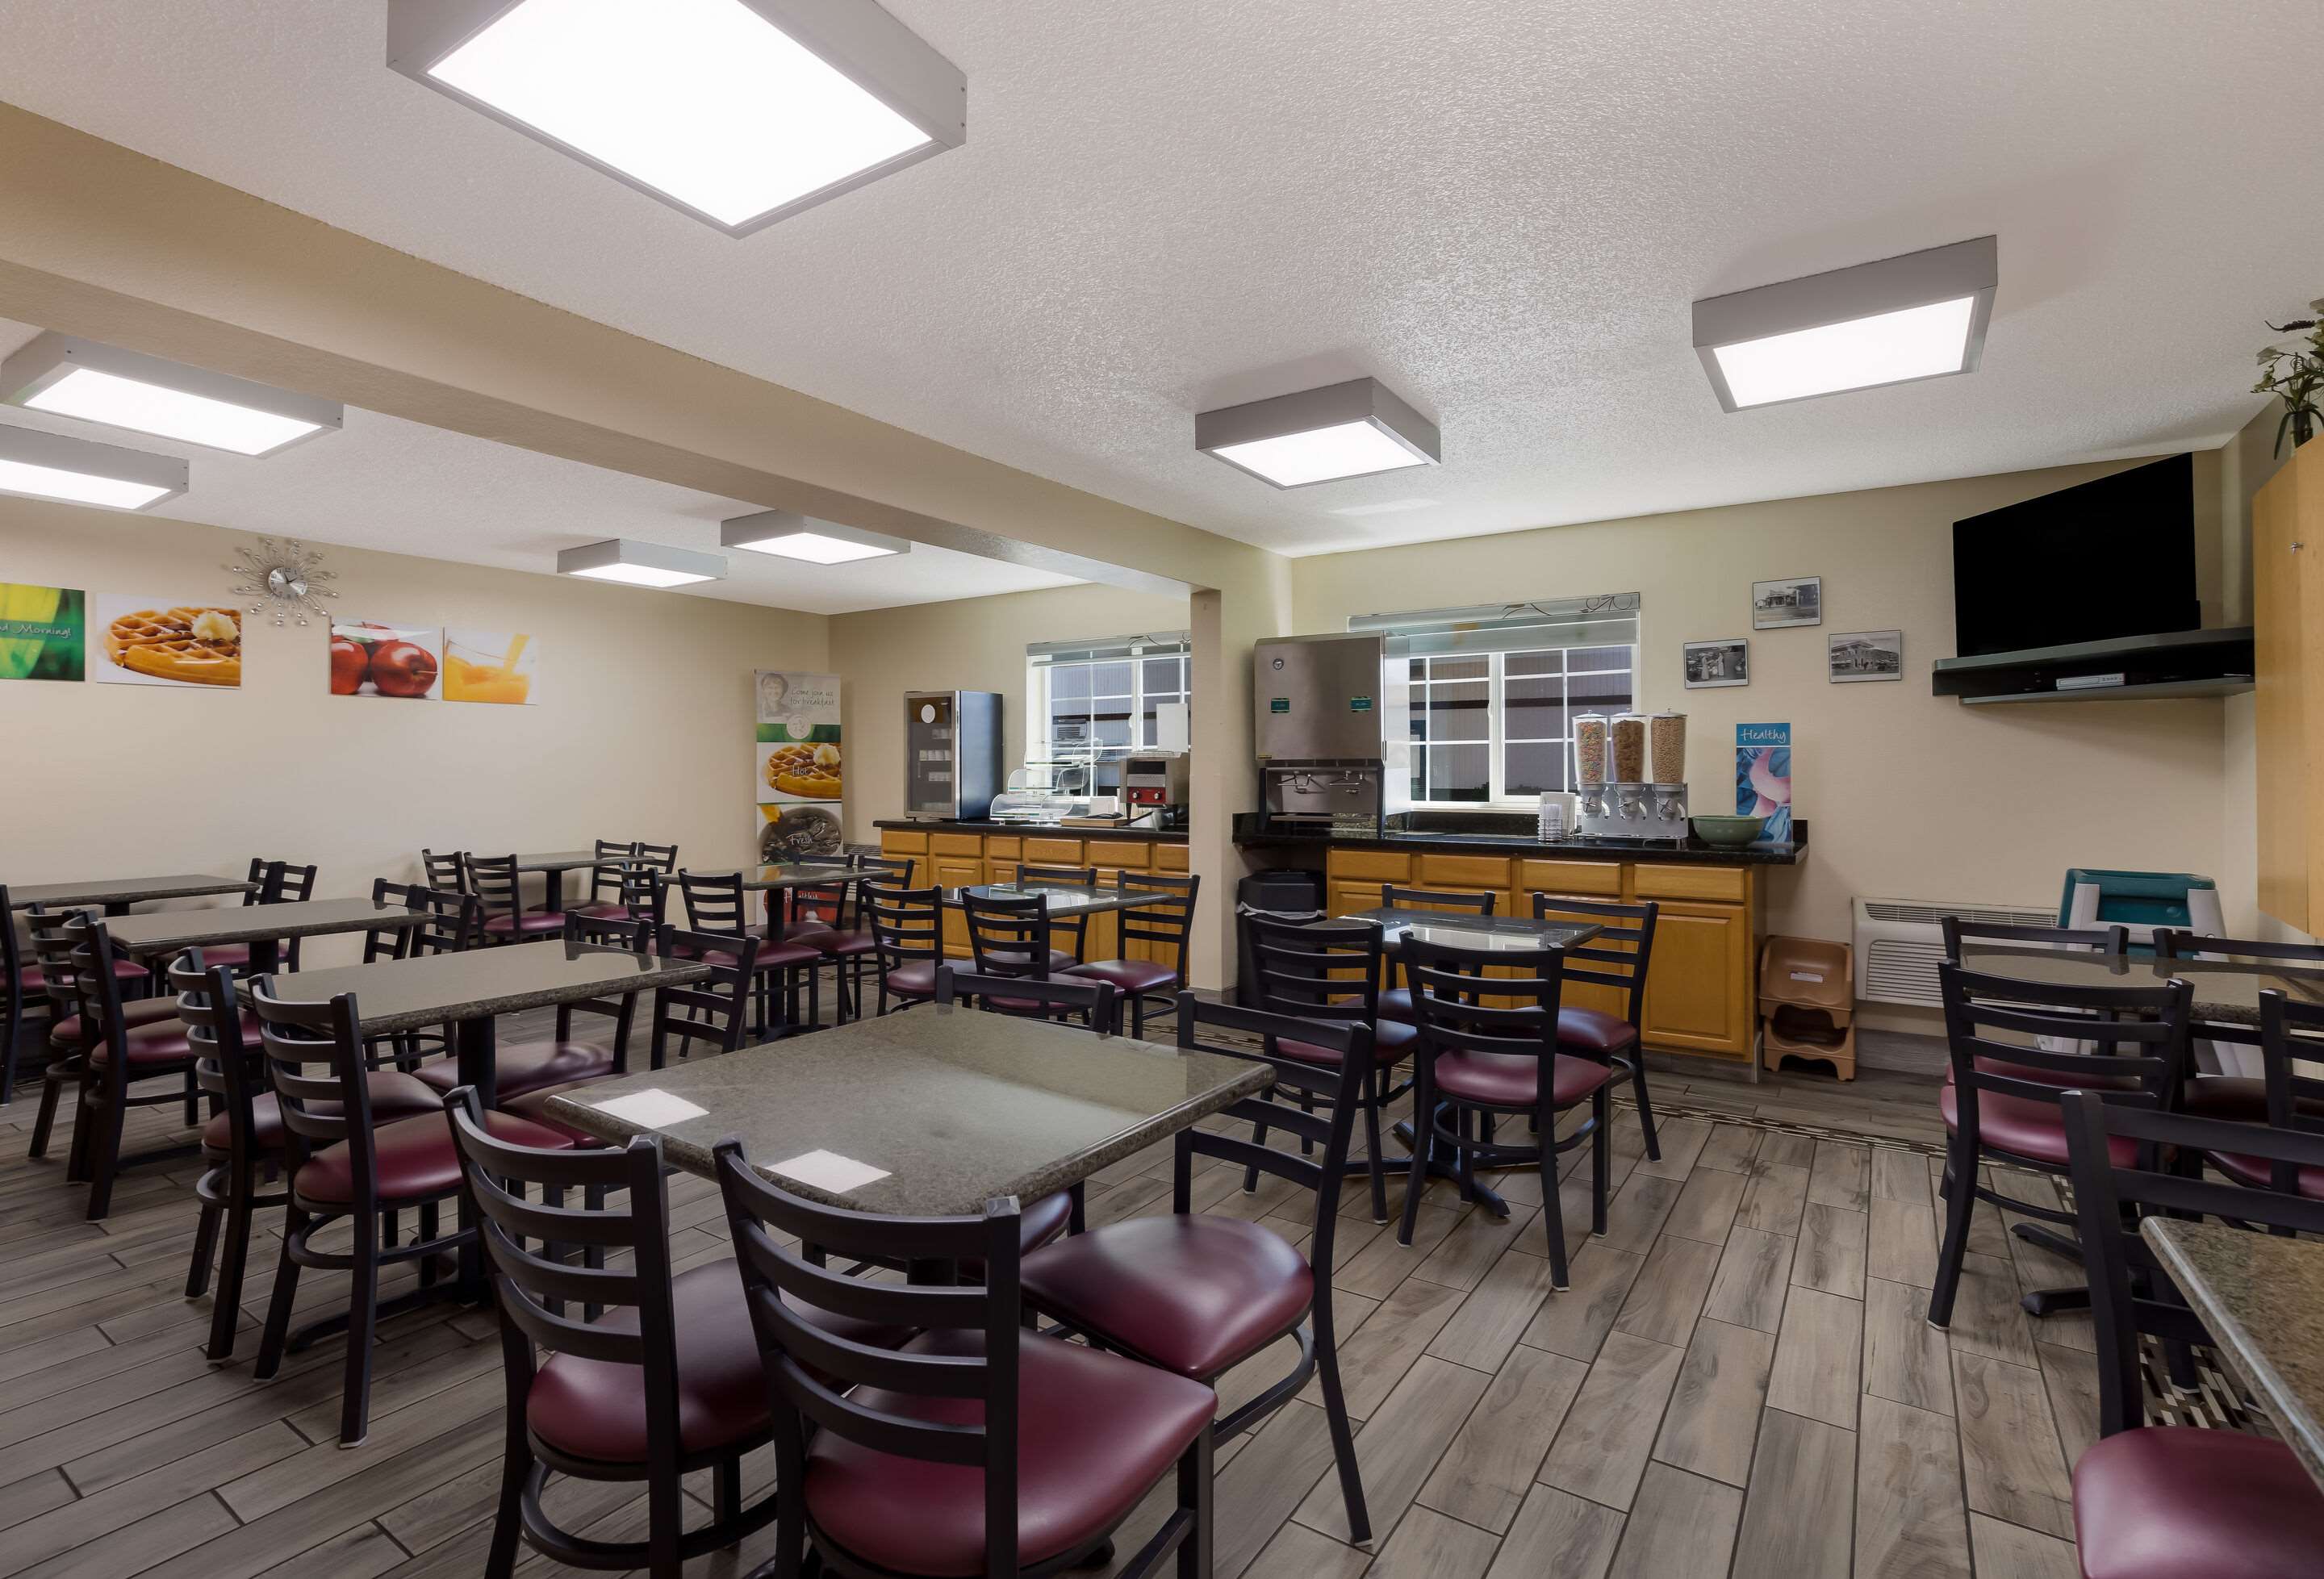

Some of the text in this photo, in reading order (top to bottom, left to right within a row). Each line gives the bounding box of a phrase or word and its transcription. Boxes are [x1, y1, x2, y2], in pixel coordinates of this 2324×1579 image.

[12, 624, 72, 639] Morning!
[1740, 728, 1787, 744] Healthy
[792, 764, 809, 775] Hot
[786, 833, 813, 846] Fresh
